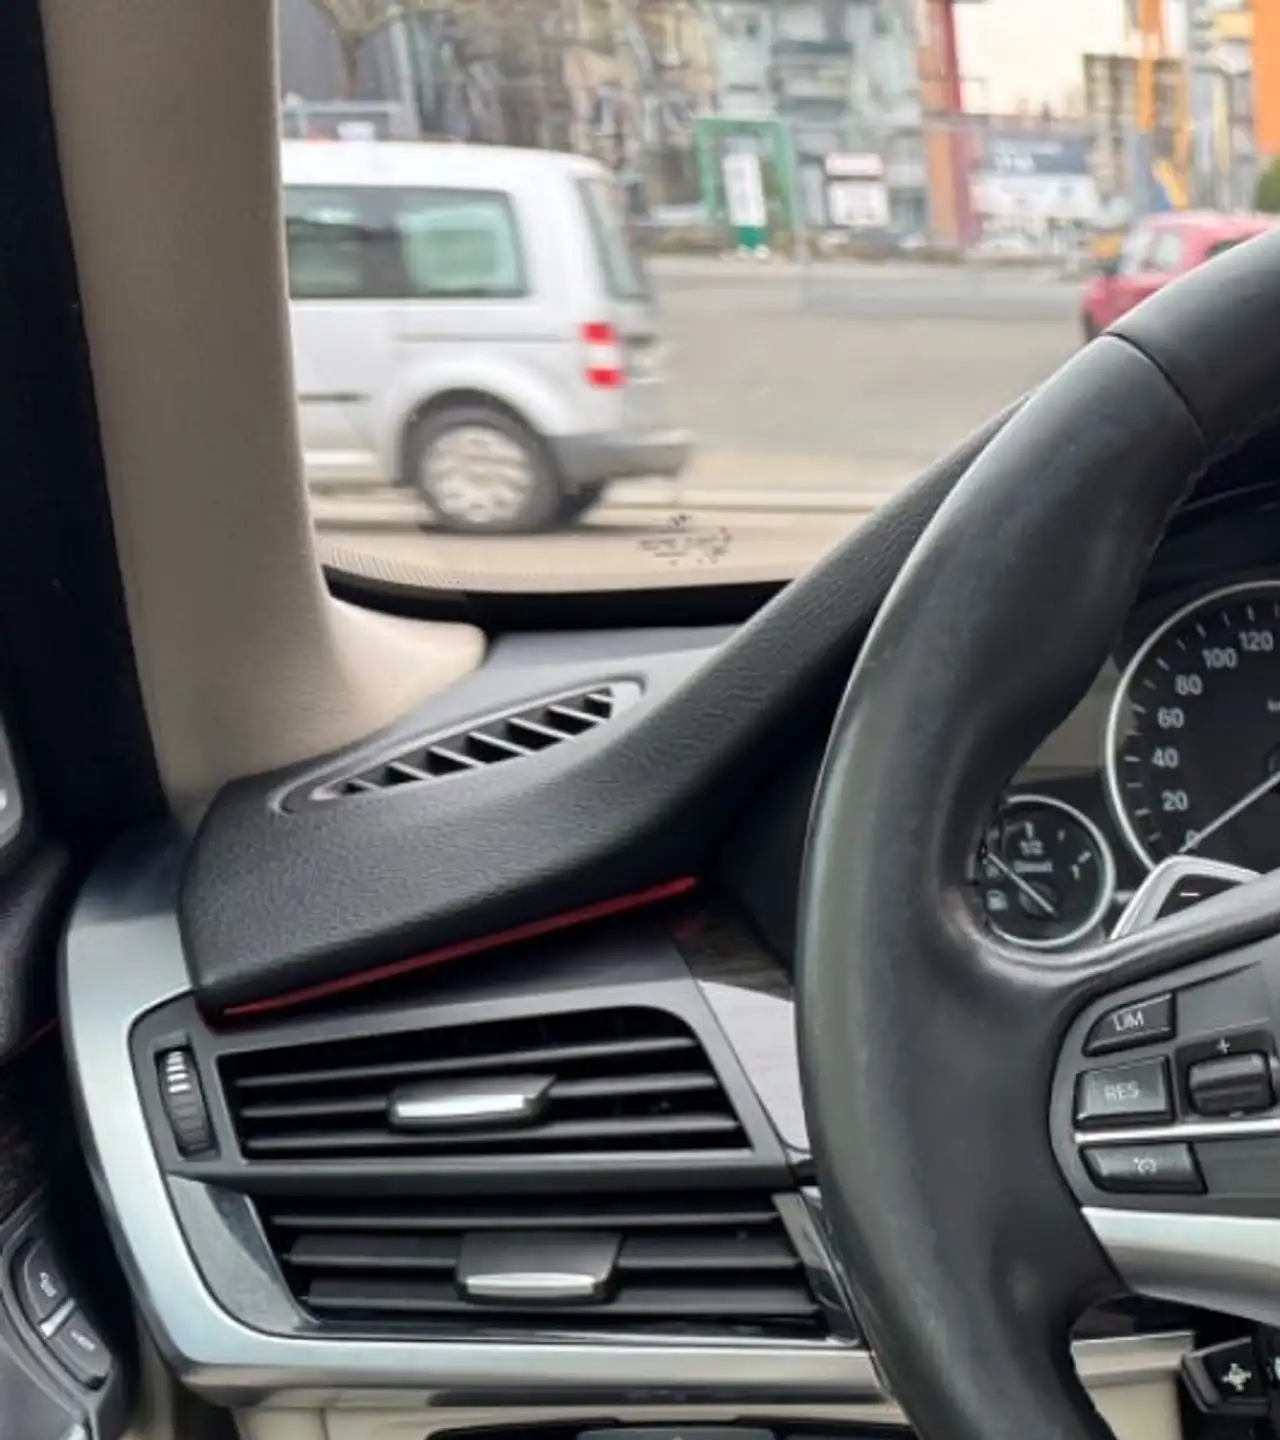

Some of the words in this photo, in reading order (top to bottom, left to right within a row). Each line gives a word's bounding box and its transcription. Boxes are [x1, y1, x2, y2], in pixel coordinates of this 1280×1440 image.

[1238, 631, 1274, 651] 120
[1202, 648, 1239, 669] 100
[1174, 674, 1203, 696] 80
[1156, 706, 1185, 729] 60
[1151, 747, 1179, 769] 40
[1160, 789, 1189, 812] 20
